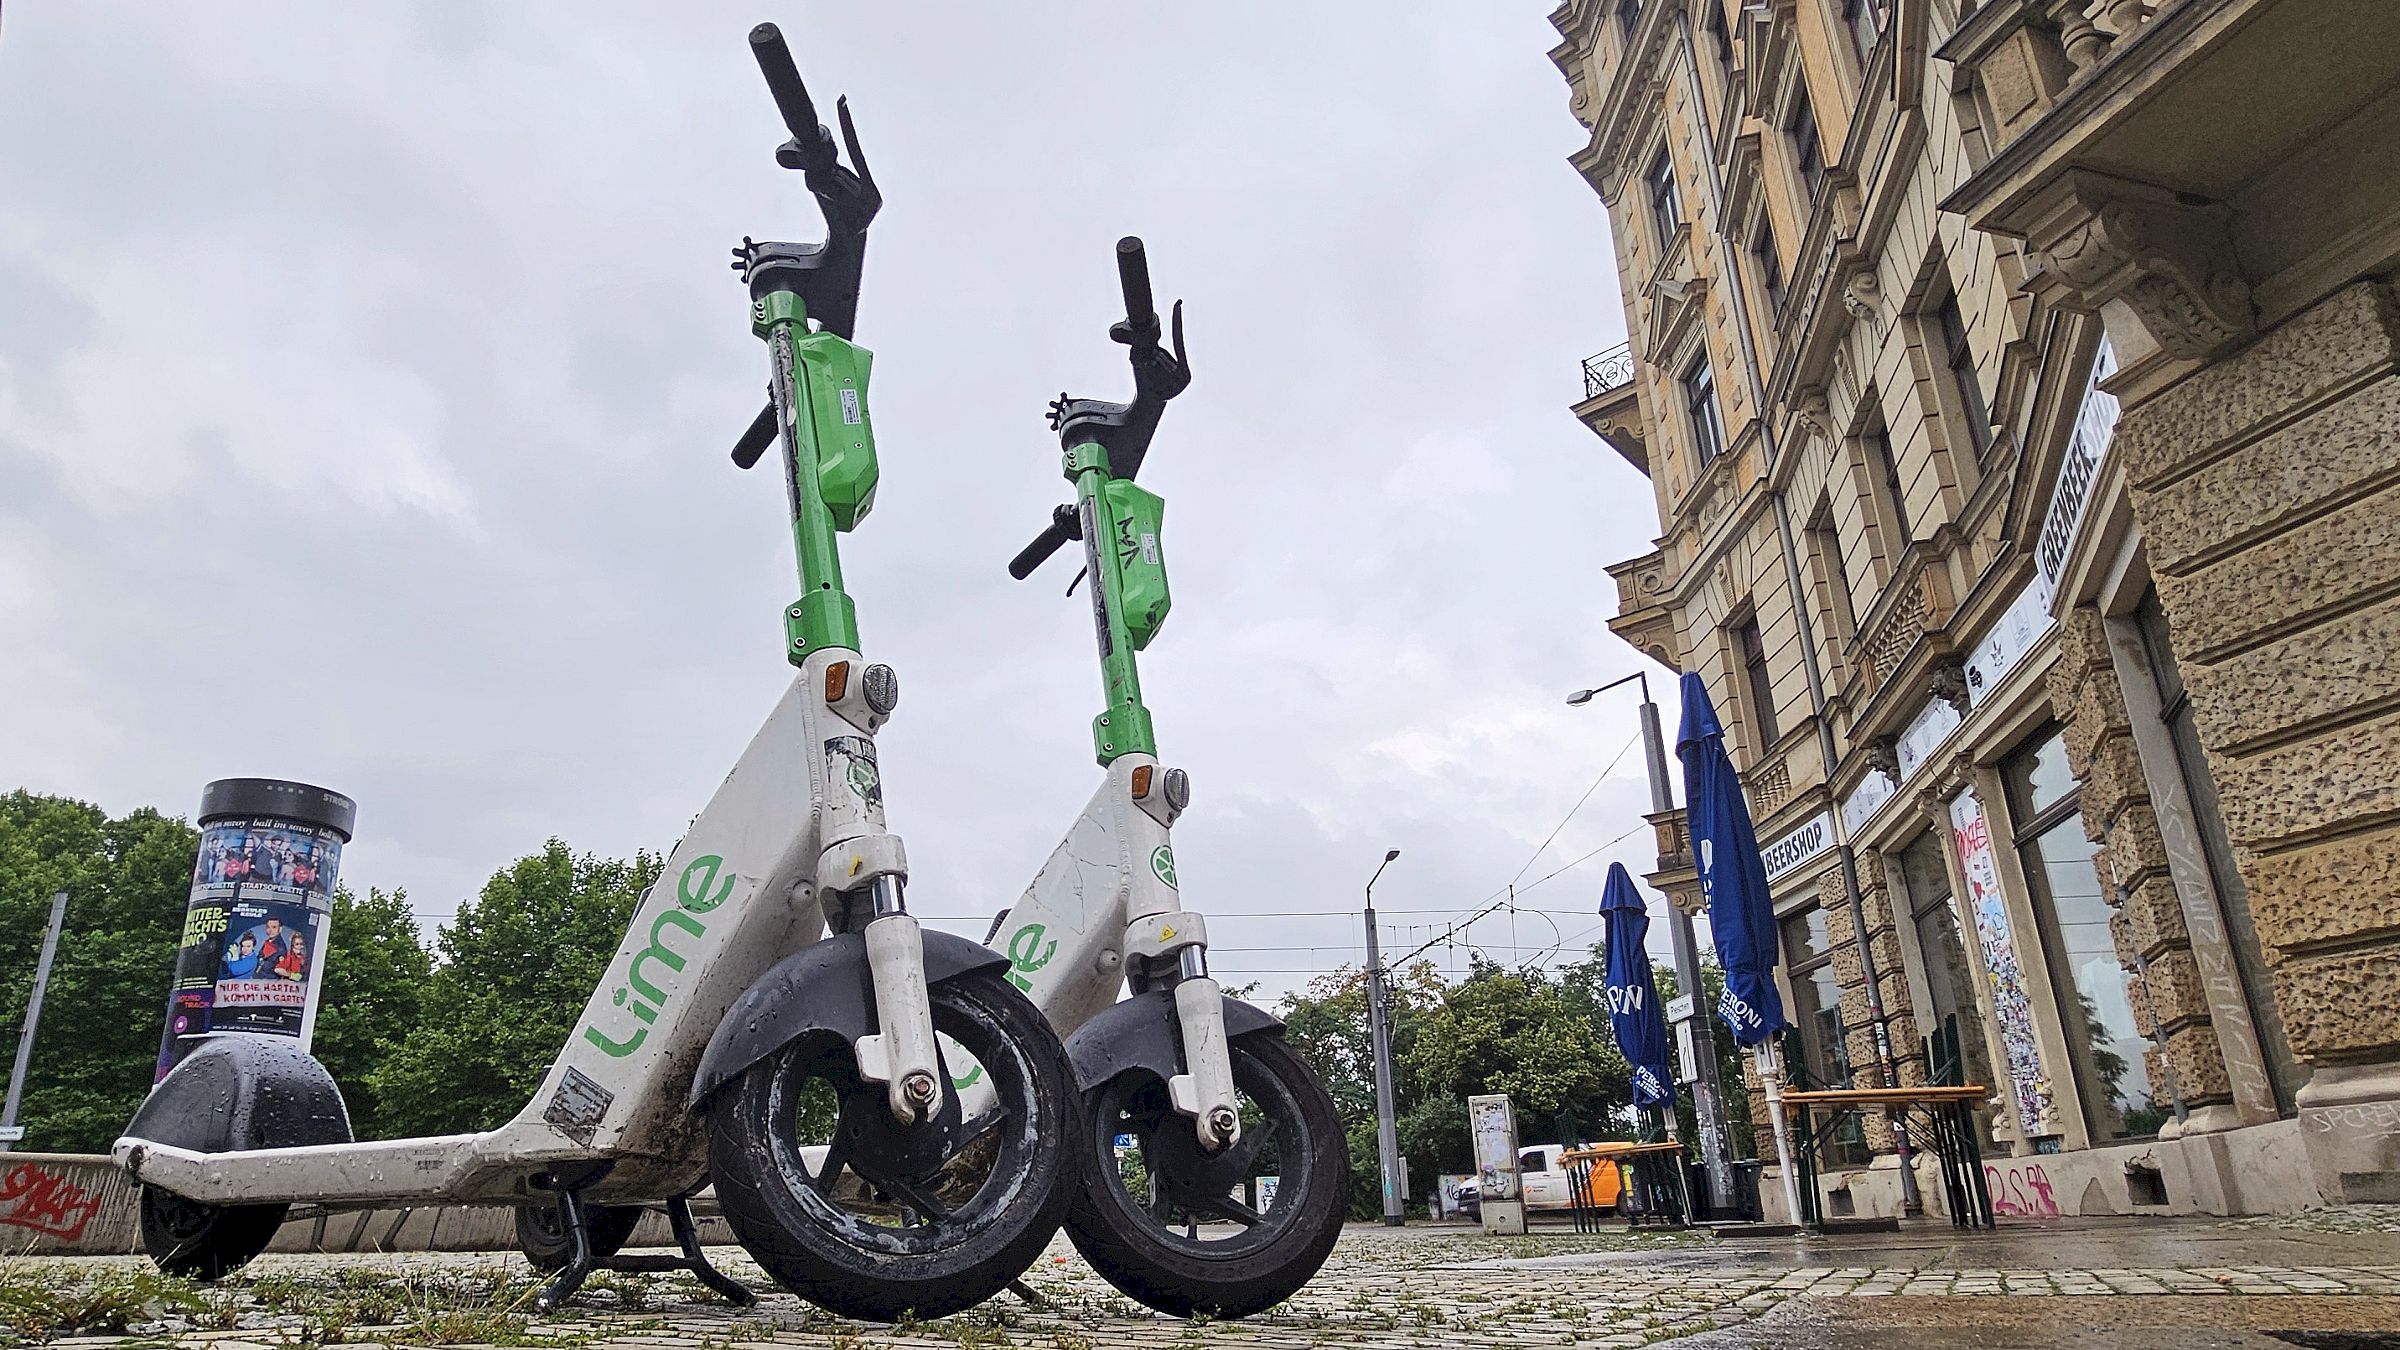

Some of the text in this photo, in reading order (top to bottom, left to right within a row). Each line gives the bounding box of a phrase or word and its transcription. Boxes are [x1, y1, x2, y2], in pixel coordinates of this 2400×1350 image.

[252, 818, 315, 836] ball im savoy
[1762, 822, 1822, 876] BEERSHOP
[240, 882, 304, 896] STAATSOPERETTE
[219, 983, 240, 992] NUR
[243, 983, 260, 991] DIE
[260, 994, 270, 1002] IN
[273, 994, 305, 1004] GARTEN
